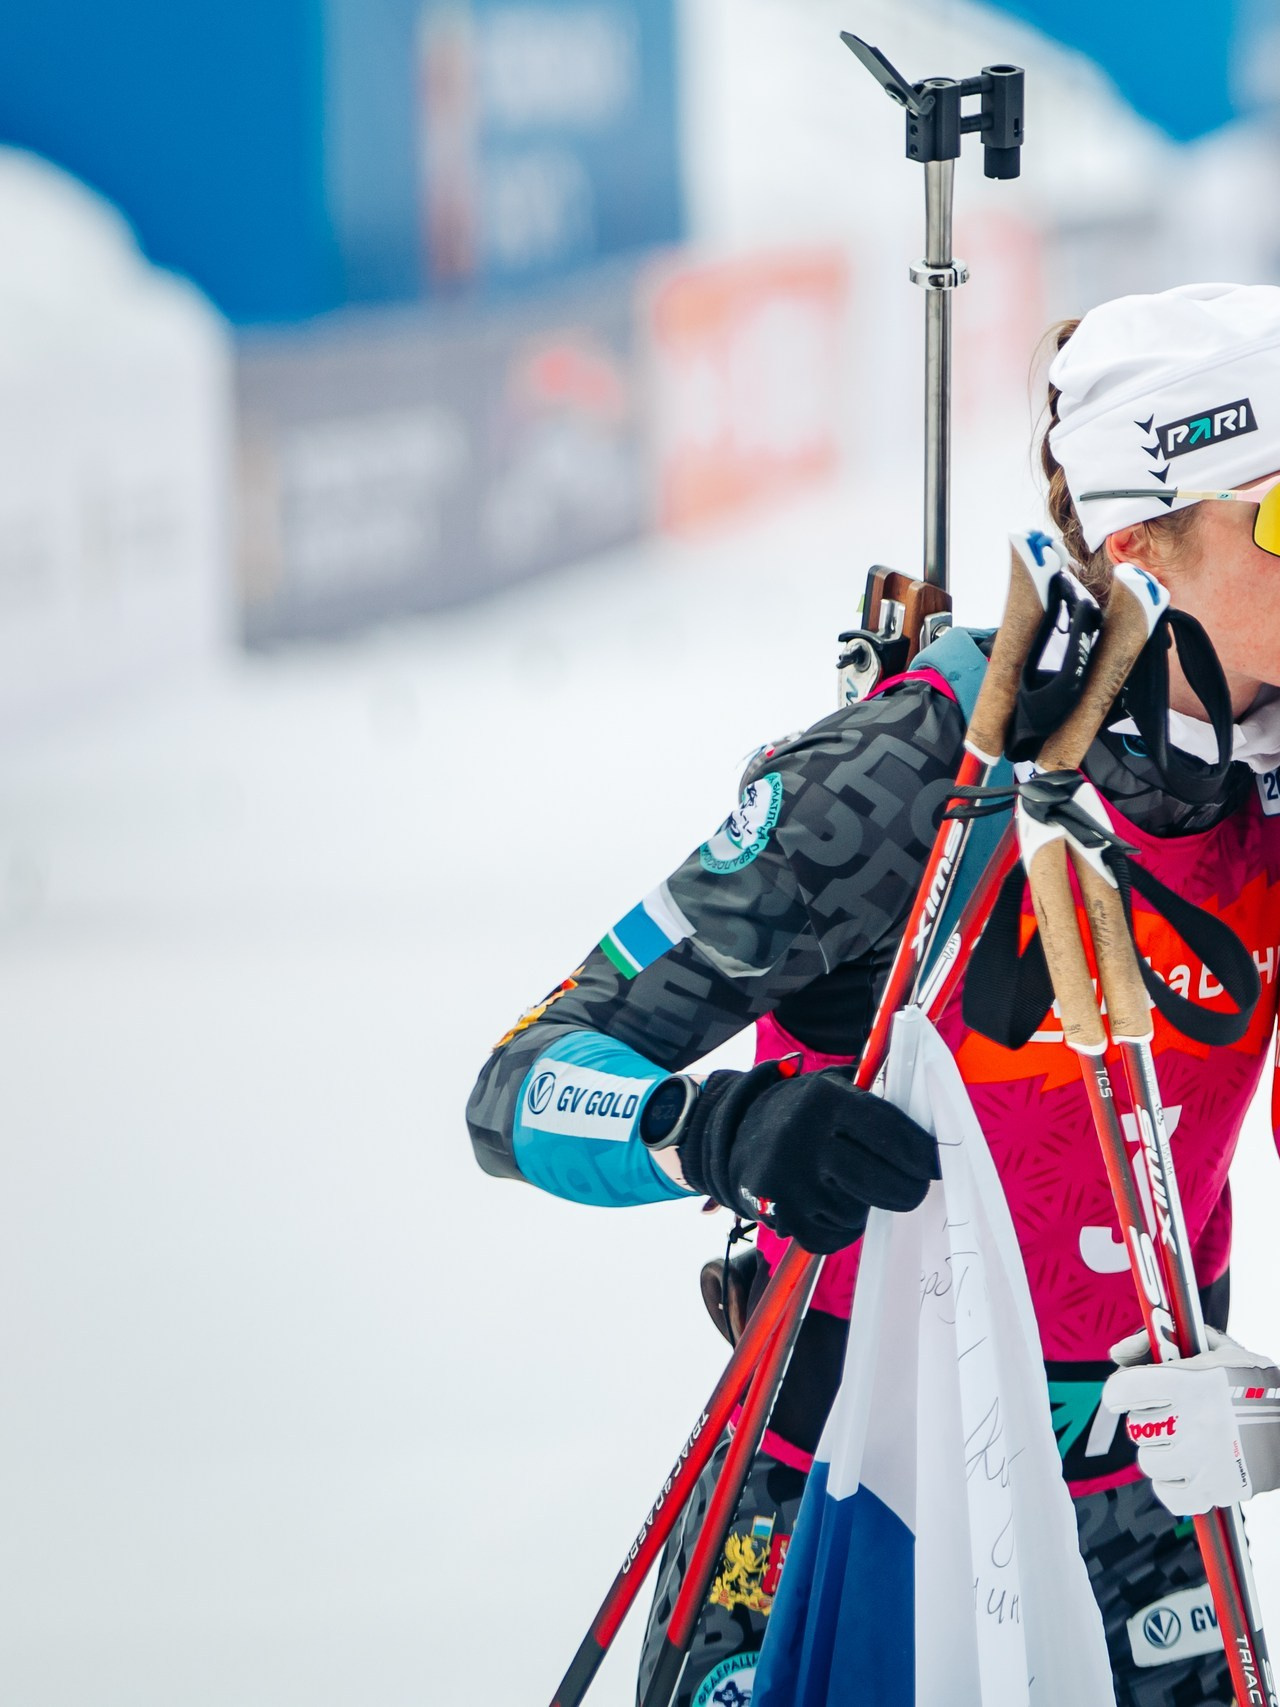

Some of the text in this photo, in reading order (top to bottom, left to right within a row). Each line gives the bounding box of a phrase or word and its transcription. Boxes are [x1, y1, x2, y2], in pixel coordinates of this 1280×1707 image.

[1166, 404, 1248, 452] PARI
[911, 821, 963, 962] SWIX
[557, 1085, 588, 1113] GV
[585, 1090, 639, 1119] GOLD
[1135, 1104, 1178, 1255] SWIX
[1126, 1416, 1176, 1441] port
[1235, 1458, 1247, 1488] Legend
[1236, 1634, 1263, 1705] TRIAC
